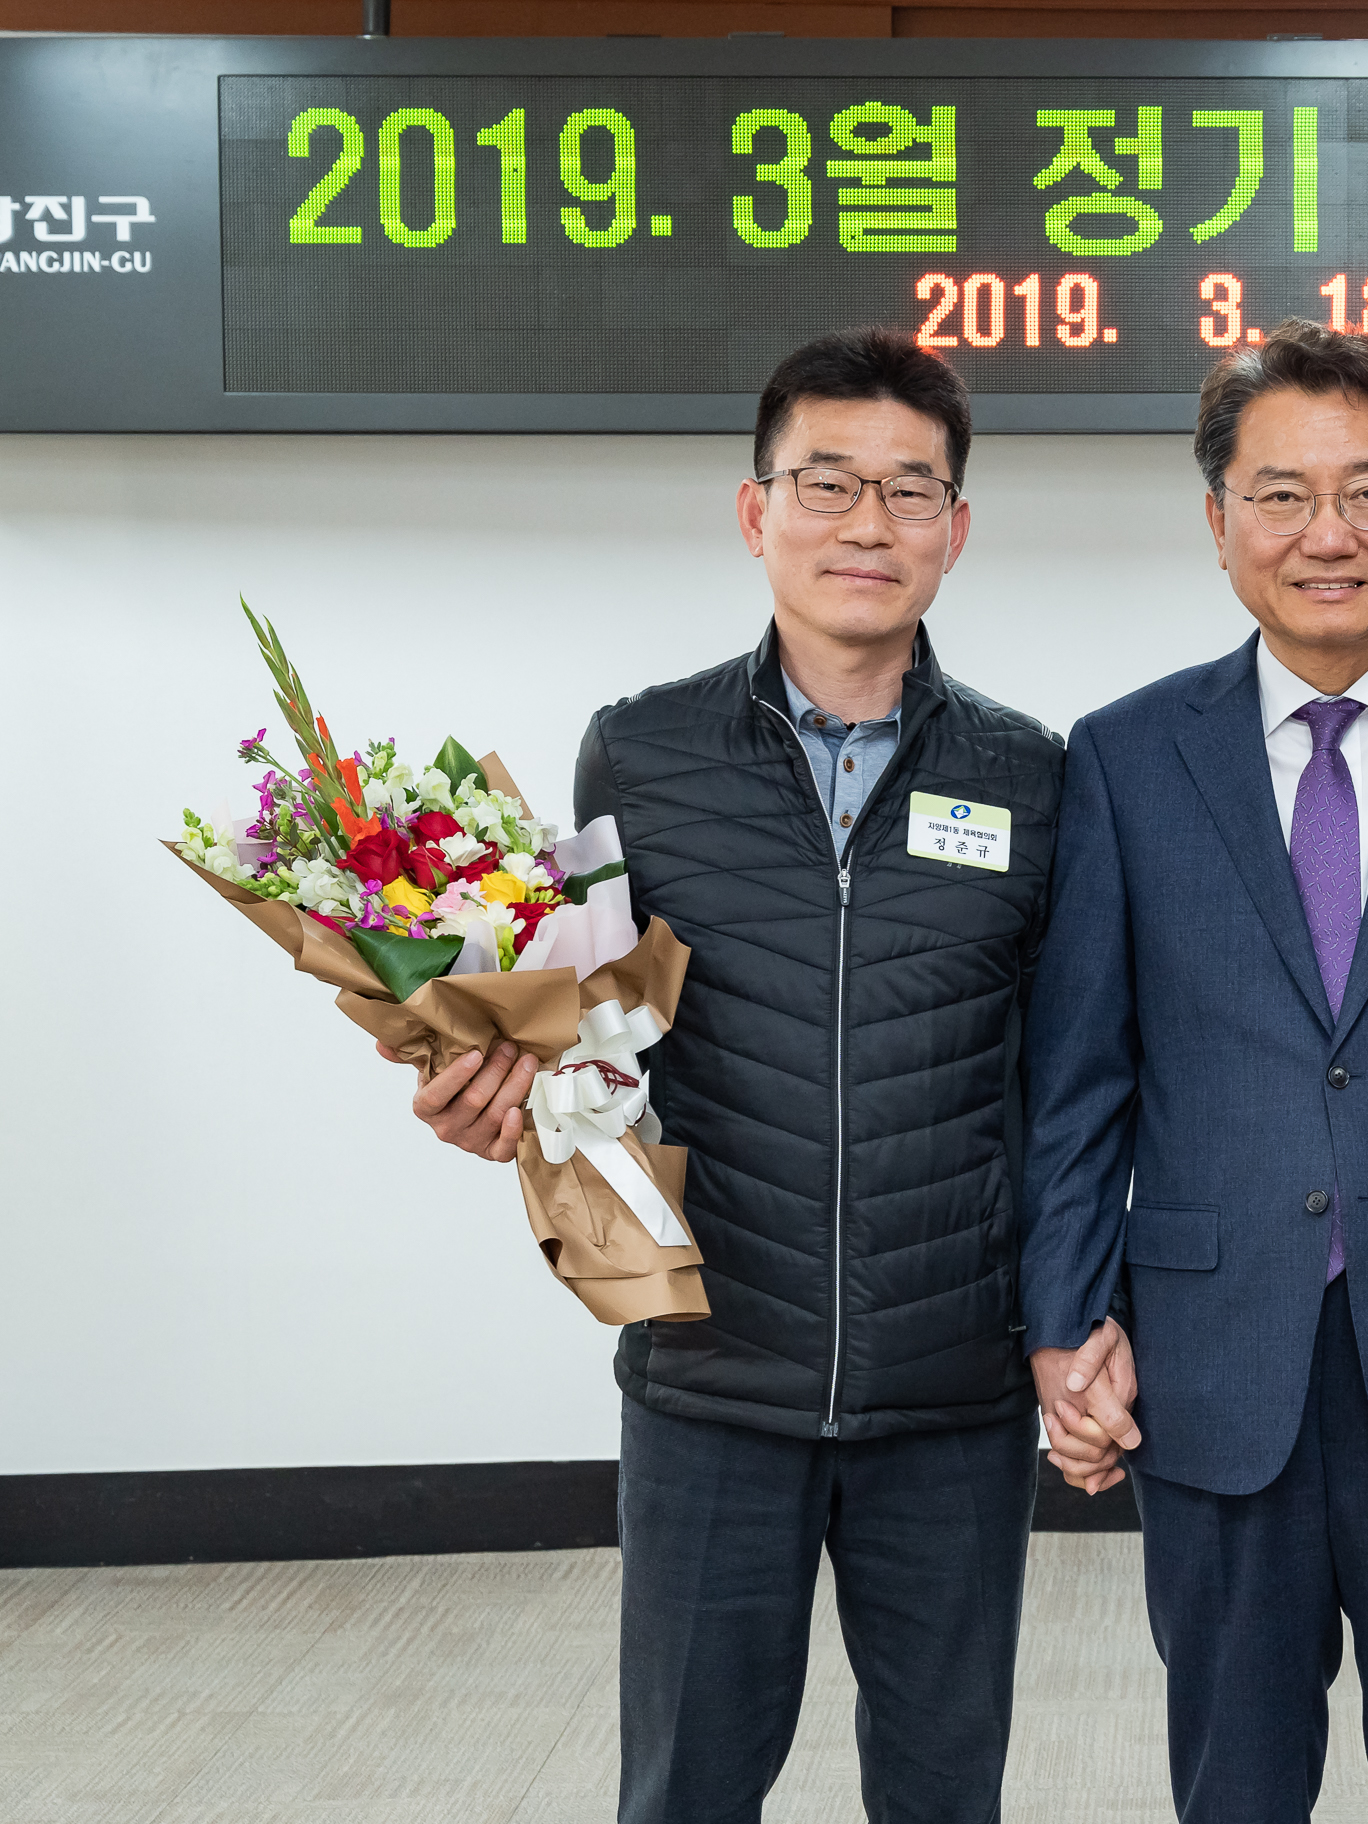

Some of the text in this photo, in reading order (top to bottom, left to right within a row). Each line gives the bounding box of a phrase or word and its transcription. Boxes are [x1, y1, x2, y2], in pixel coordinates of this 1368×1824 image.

[287, 107, 672, 248] 2019.
[731, 101, 957, 252] 3월
[1032, 105, 1318, 256] 정기
[0, 250, 152, 273] ANGJIN-GU
[915, 272, 1118, 348] 2019.
[1199, 272, 1262, 347] 3.
[928, 821, 960, 835] 자양제1동
